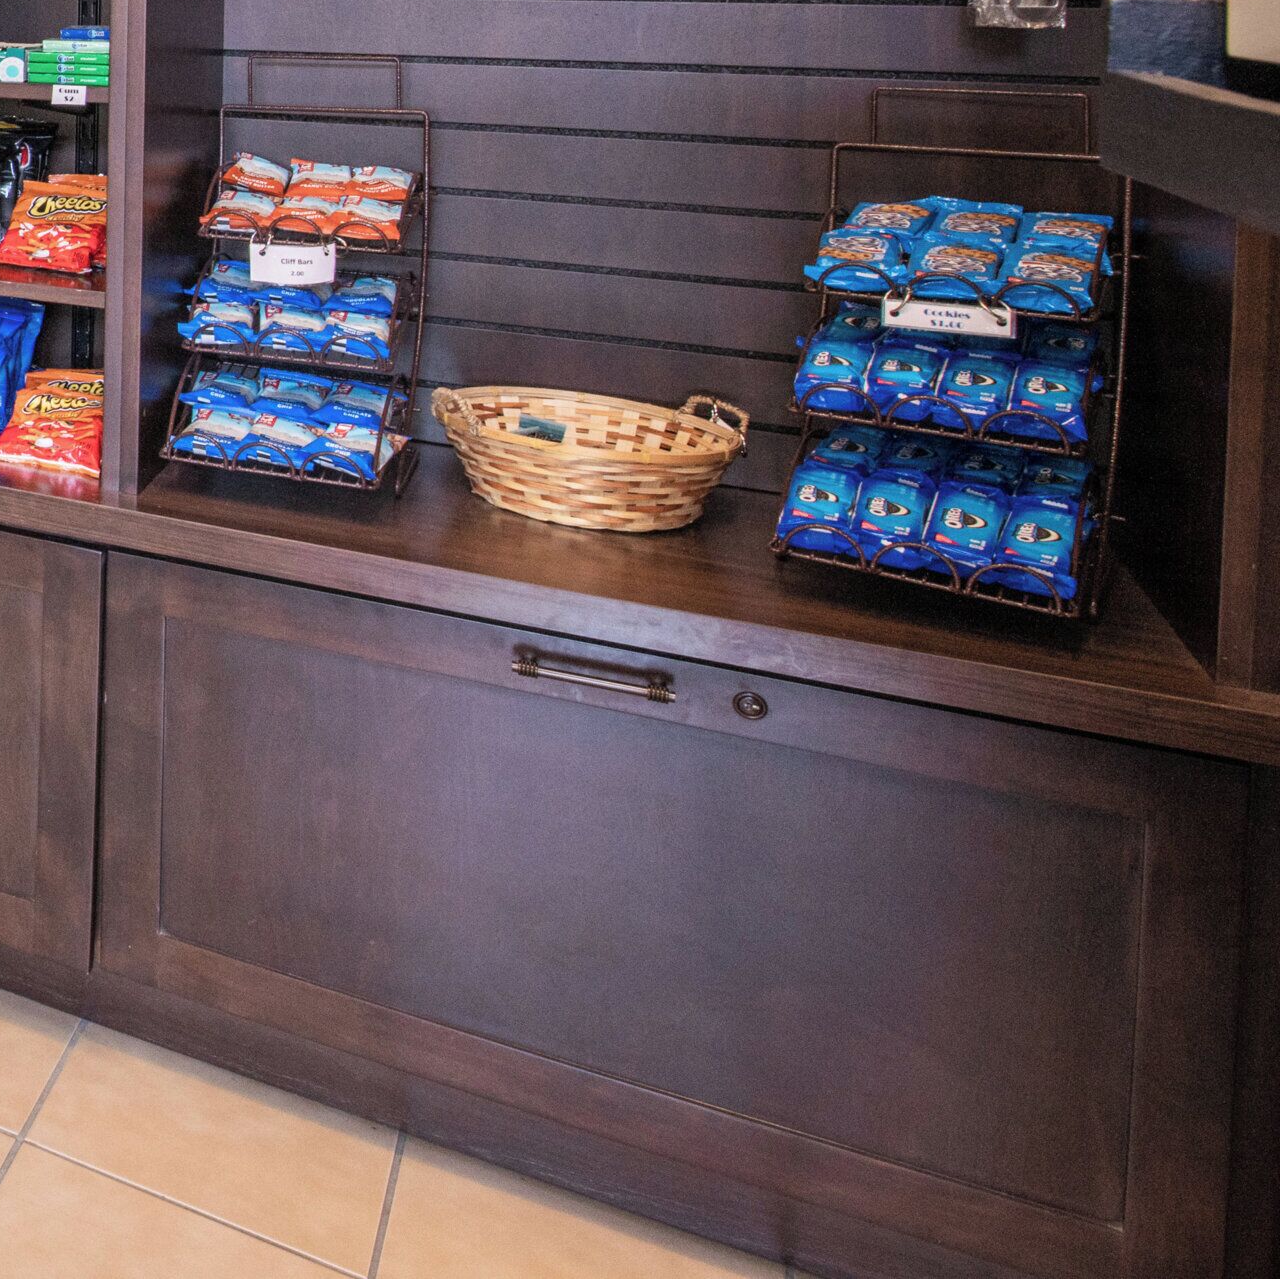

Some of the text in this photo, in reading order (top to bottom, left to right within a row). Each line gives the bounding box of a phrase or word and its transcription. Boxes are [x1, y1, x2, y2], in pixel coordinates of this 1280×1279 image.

[28, 194, 108, 217] Cheetos
[280, 257, 314, 267] Cliff Bars
[923, 307, 971, 320] Cookies
[930, 317, 965, 330] $1.00
